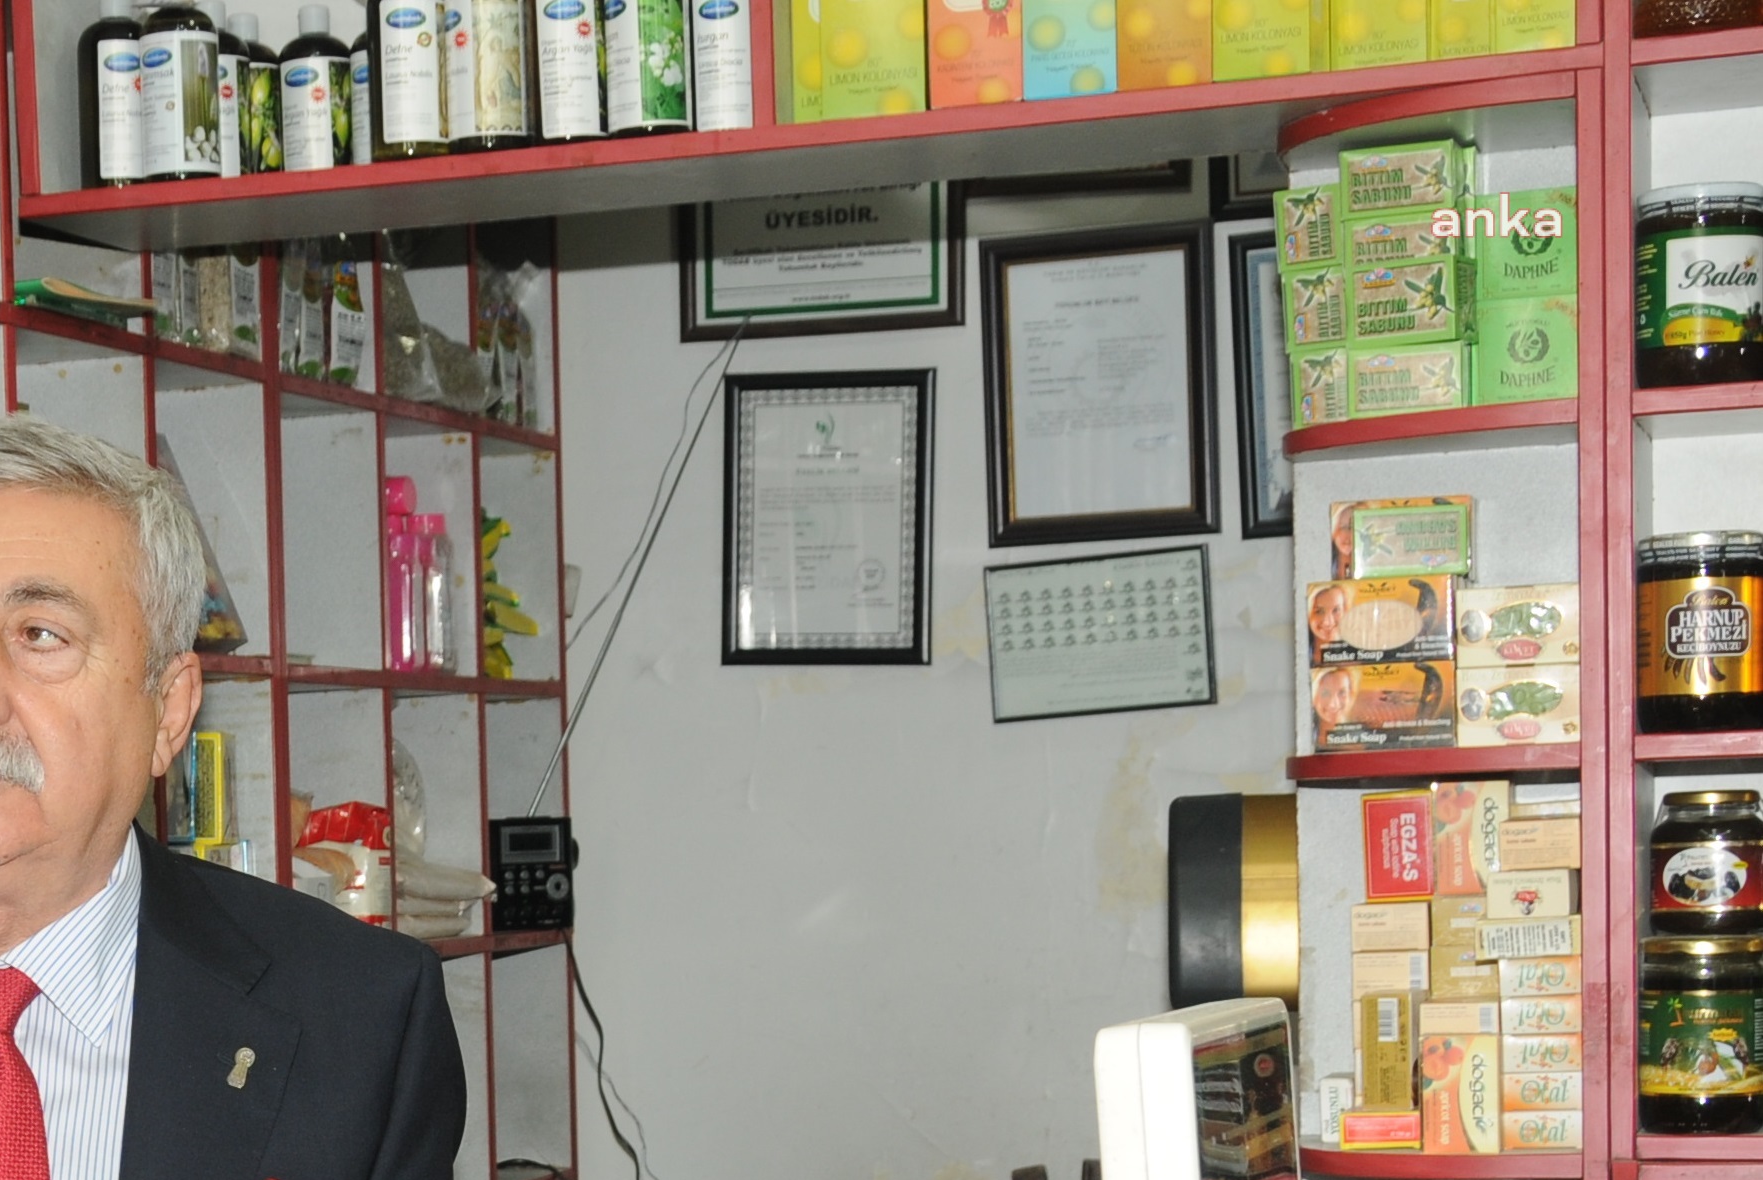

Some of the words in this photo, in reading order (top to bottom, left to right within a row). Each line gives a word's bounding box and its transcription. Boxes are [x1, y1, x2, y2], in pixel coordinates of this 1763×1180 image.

[1503, 256, 1560, 280] DAPHNE
[1678, 259, 1759, 290] Balen
[1499, 365, 1557, 389] DAPHNE
[1678, 608, 1745, 628] HARNUP
[1670, 619, 1748, 644] PEKMEZİ
[1323, 650, 1356, 662] Snake
[1357, 649, 1384, 663] Soap
[1326, 732, 1359, 745] Snake
